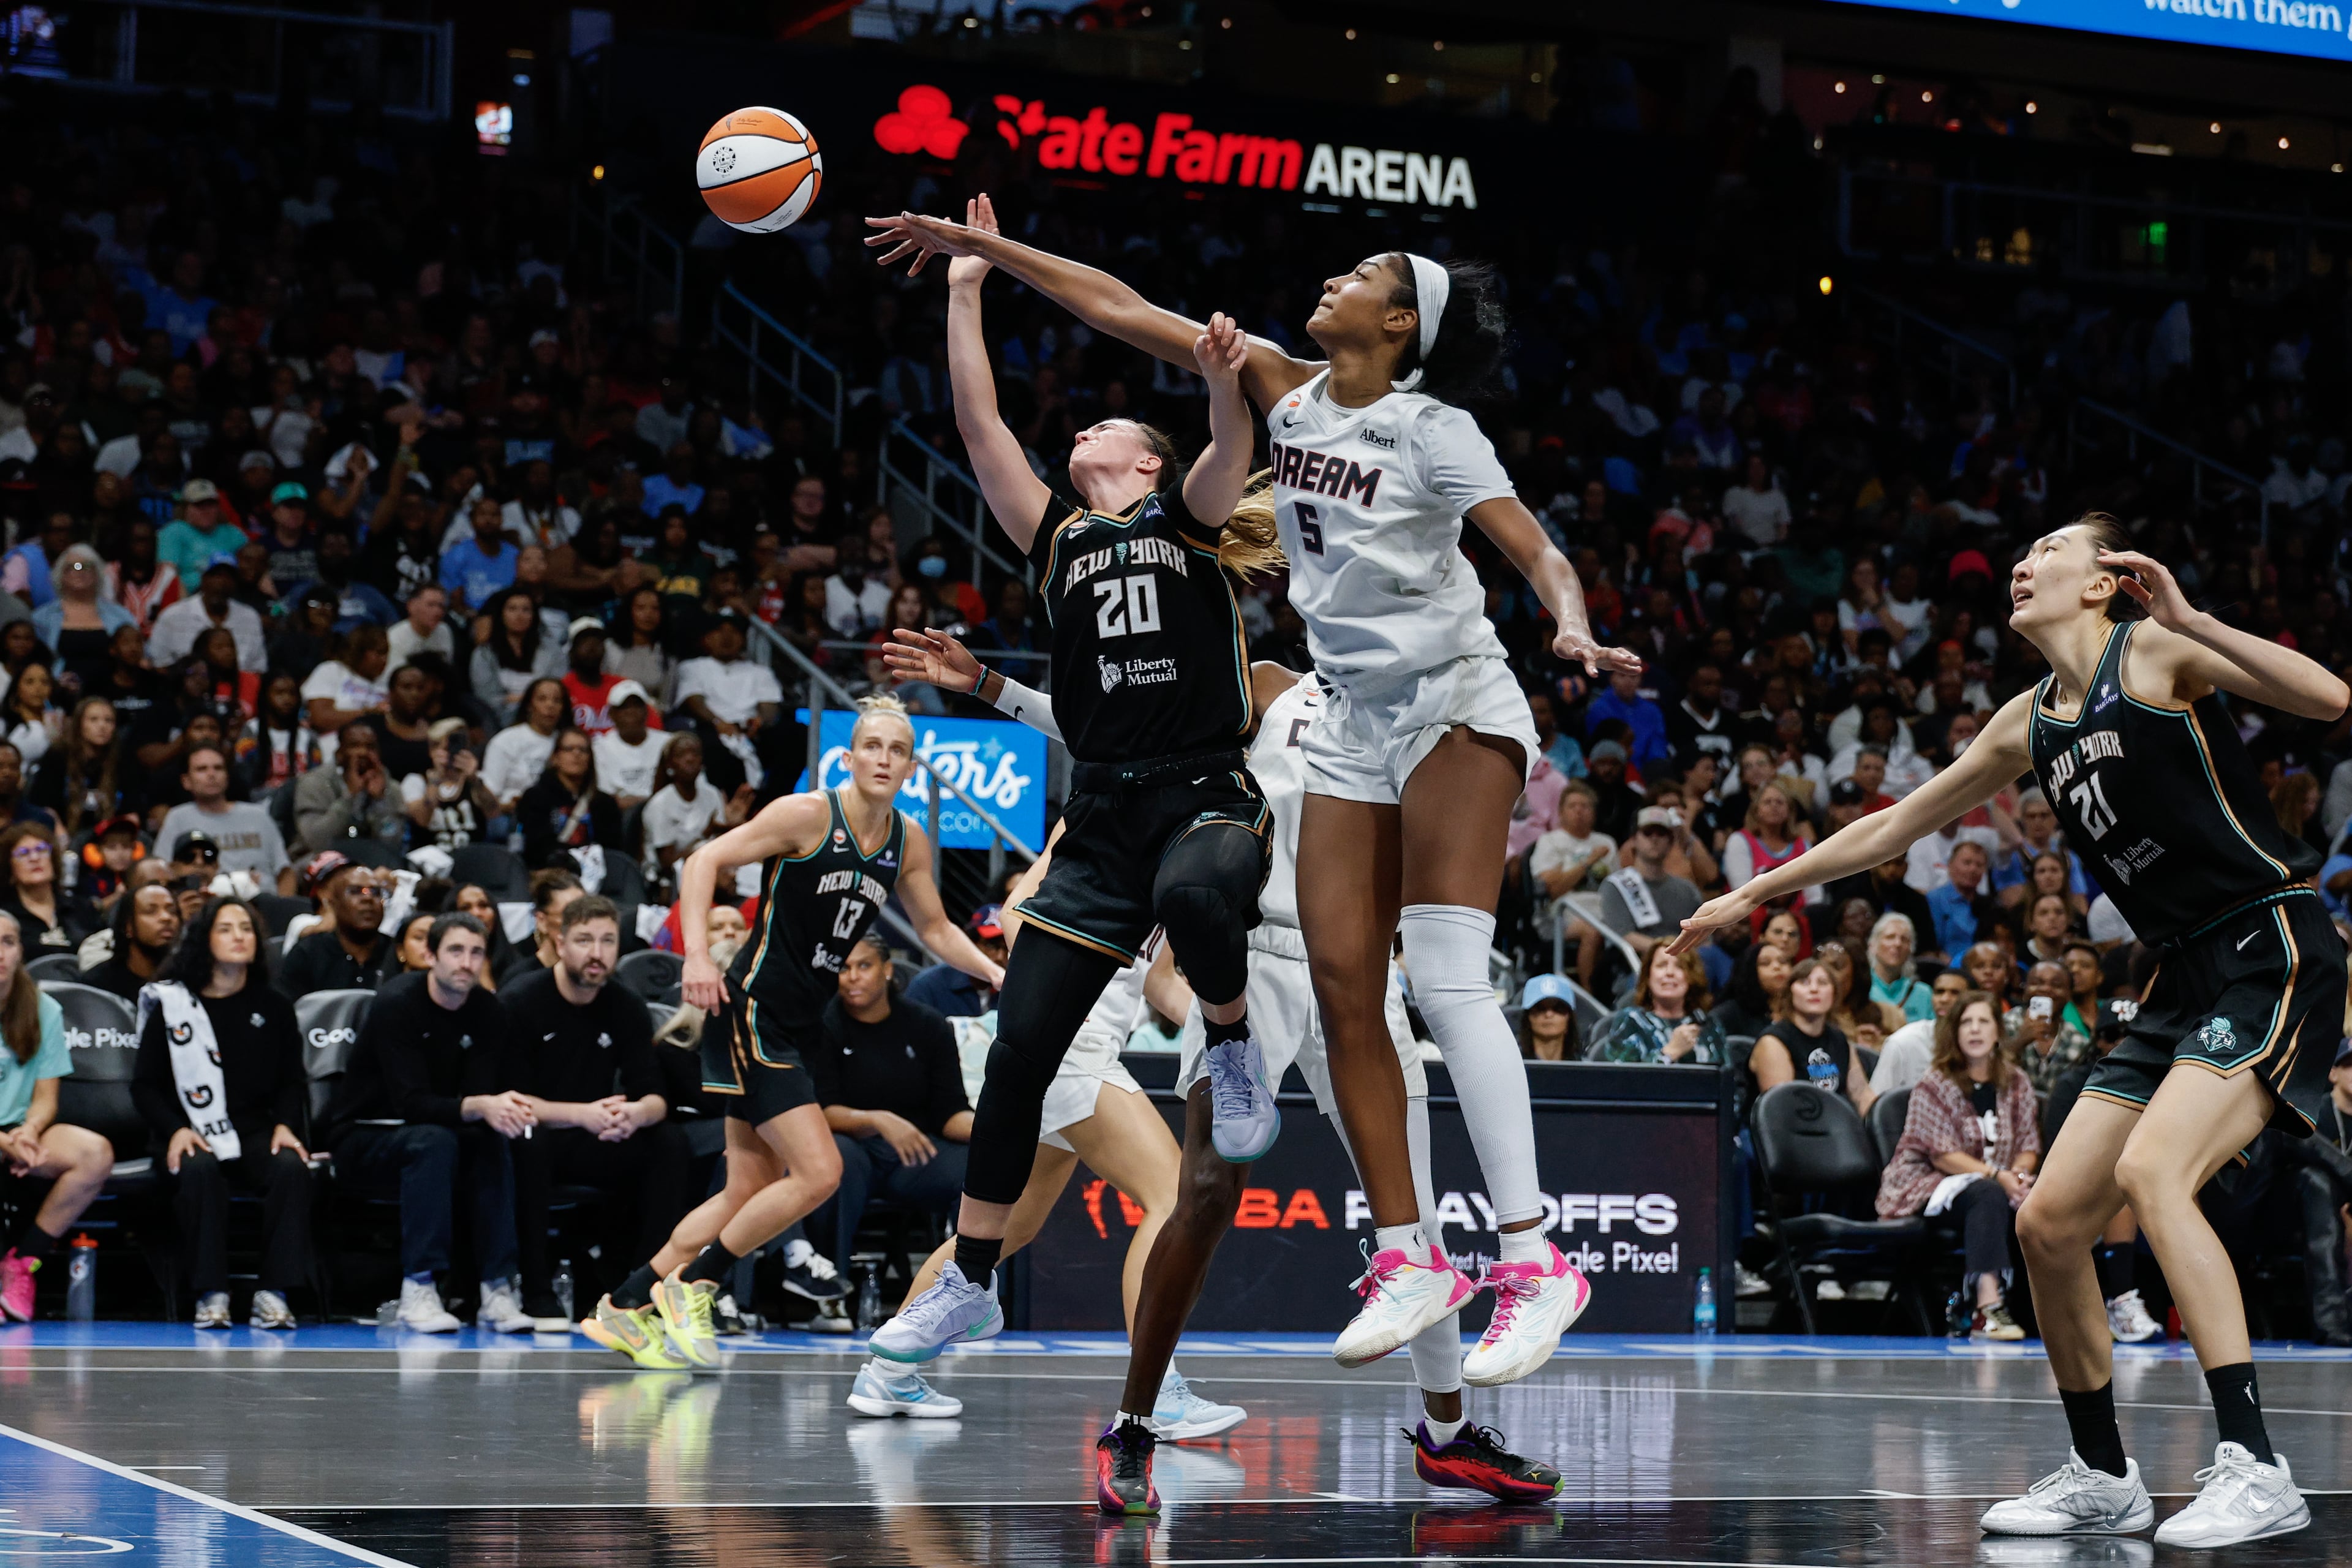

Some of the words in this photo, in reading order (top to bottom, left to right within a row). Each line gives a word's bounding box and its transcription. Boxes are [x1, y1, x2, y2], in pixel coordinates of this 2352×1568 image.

[2254, 0, 2343, 32] them
[1145, 111, 1303, 191] Farm
[1303, 143, 1478, 209] ARENA
[1360, 427, 1396, 450] Albert
[1272, 441, 1382, 508] DREAM
[1294, 501, 1324, 556] 5
[1063, 546, 1113, 599] NEW
[1128, 536, 1188, 578] YORK
[1093, 573, 1161, 639] 20
[1125, 658, 1176, 673] Liberty
[1127, 668, 1178, 687] Mutual
[2078, 729, 2125, 765] YORK
[2069, 770, 2117, 842] 21
[2122, 837, 2155, 862] Liberty
[2132, 843, 2166, 873] Mutual
[816, 870, 854, 895] NEW
[832, 897, 867, 940] 13
[1611, 1240, 1679, 1274] Pixel
